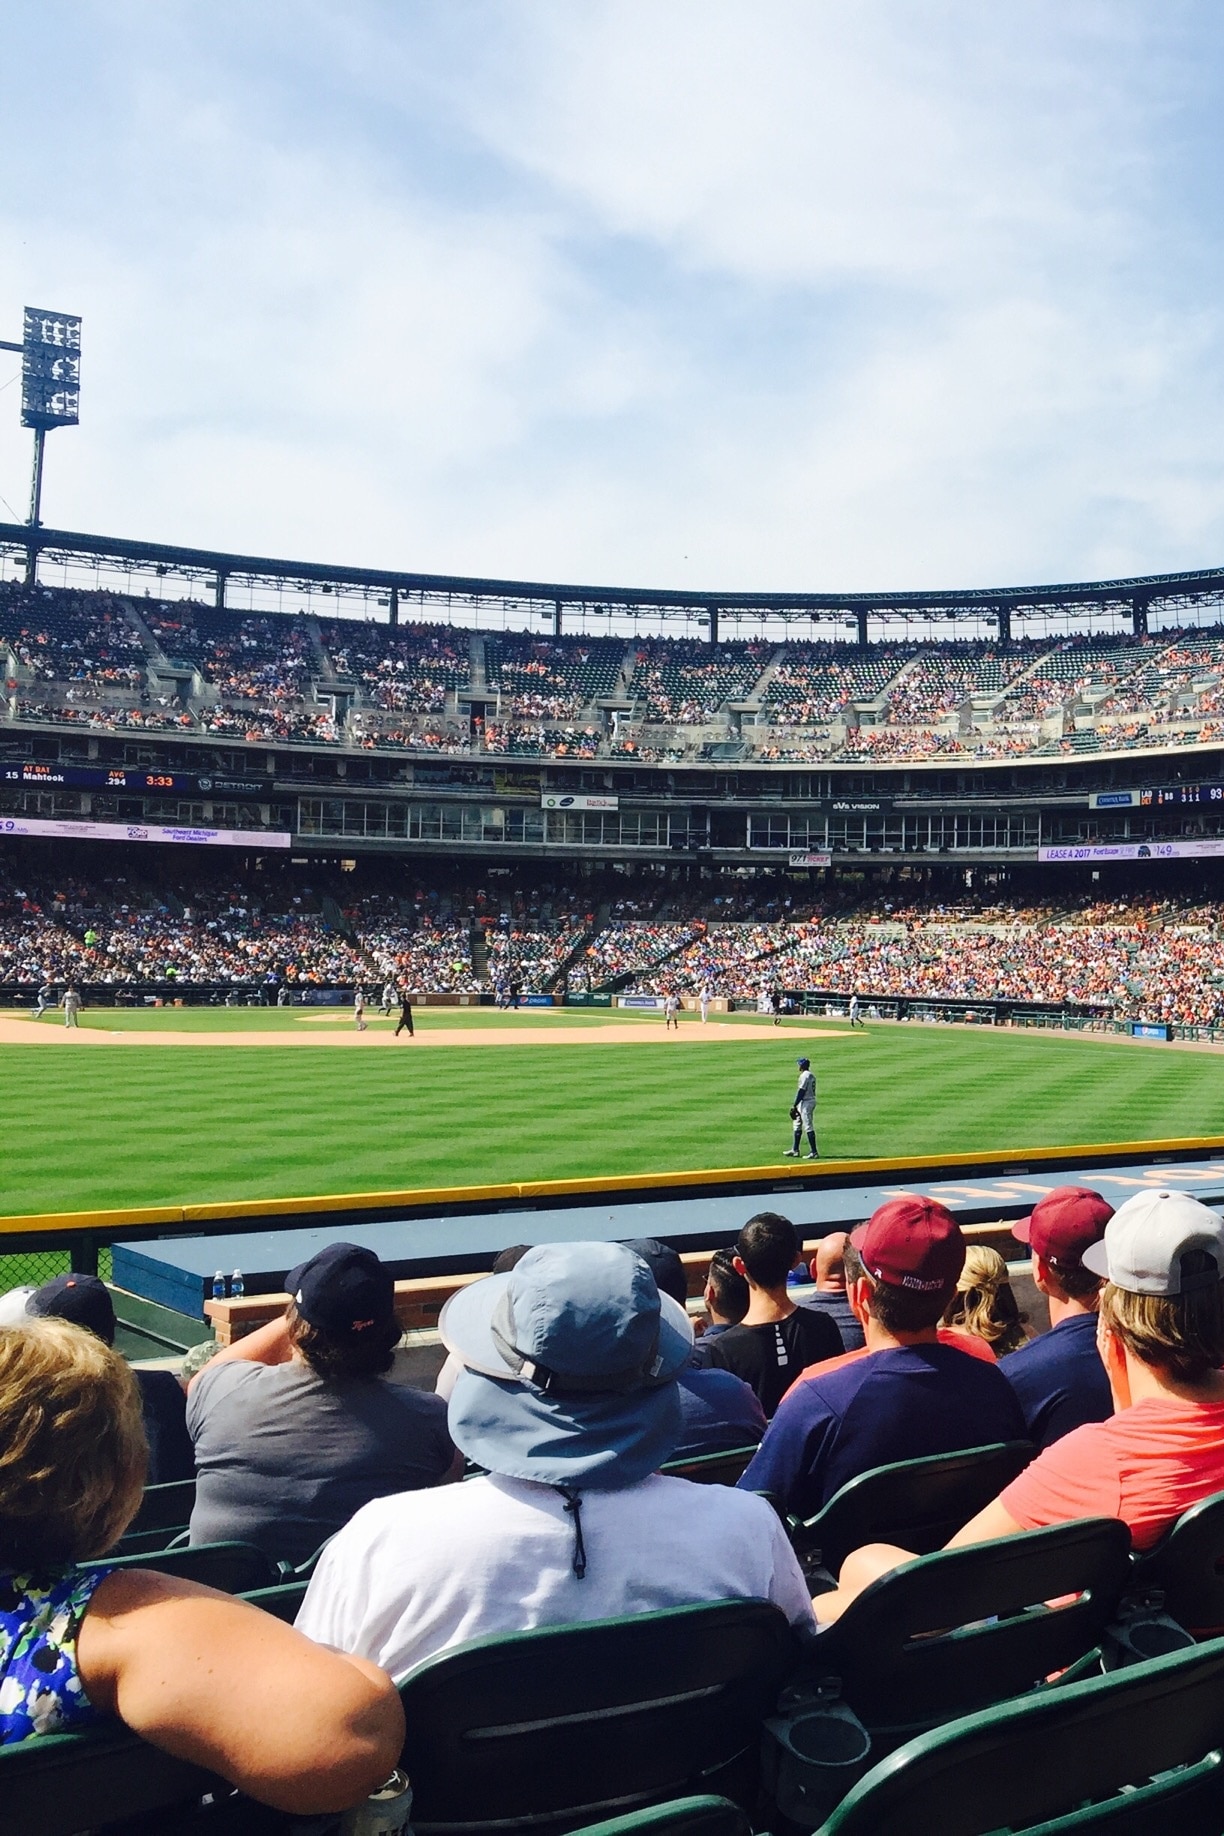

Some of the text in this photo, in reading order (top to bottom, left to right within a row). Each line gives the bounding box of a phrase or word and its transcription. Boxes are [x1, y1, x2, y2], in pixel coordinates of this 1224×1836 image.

[5, 771, 64, 782] 15 Mahtook
[108, 770, 125, 778] AVG
[105, 777, 126, 786] .294
[146, 776, 173, 787] 3:33
[1210, 788, 1223, 799] 93
[162, 828, 218, 838] Southeast Michigan
[1046, 849, 1068, 859] LEASE
[1068, 849, 1073, 858] A
[1074, 848, 1091, 858] 2017
